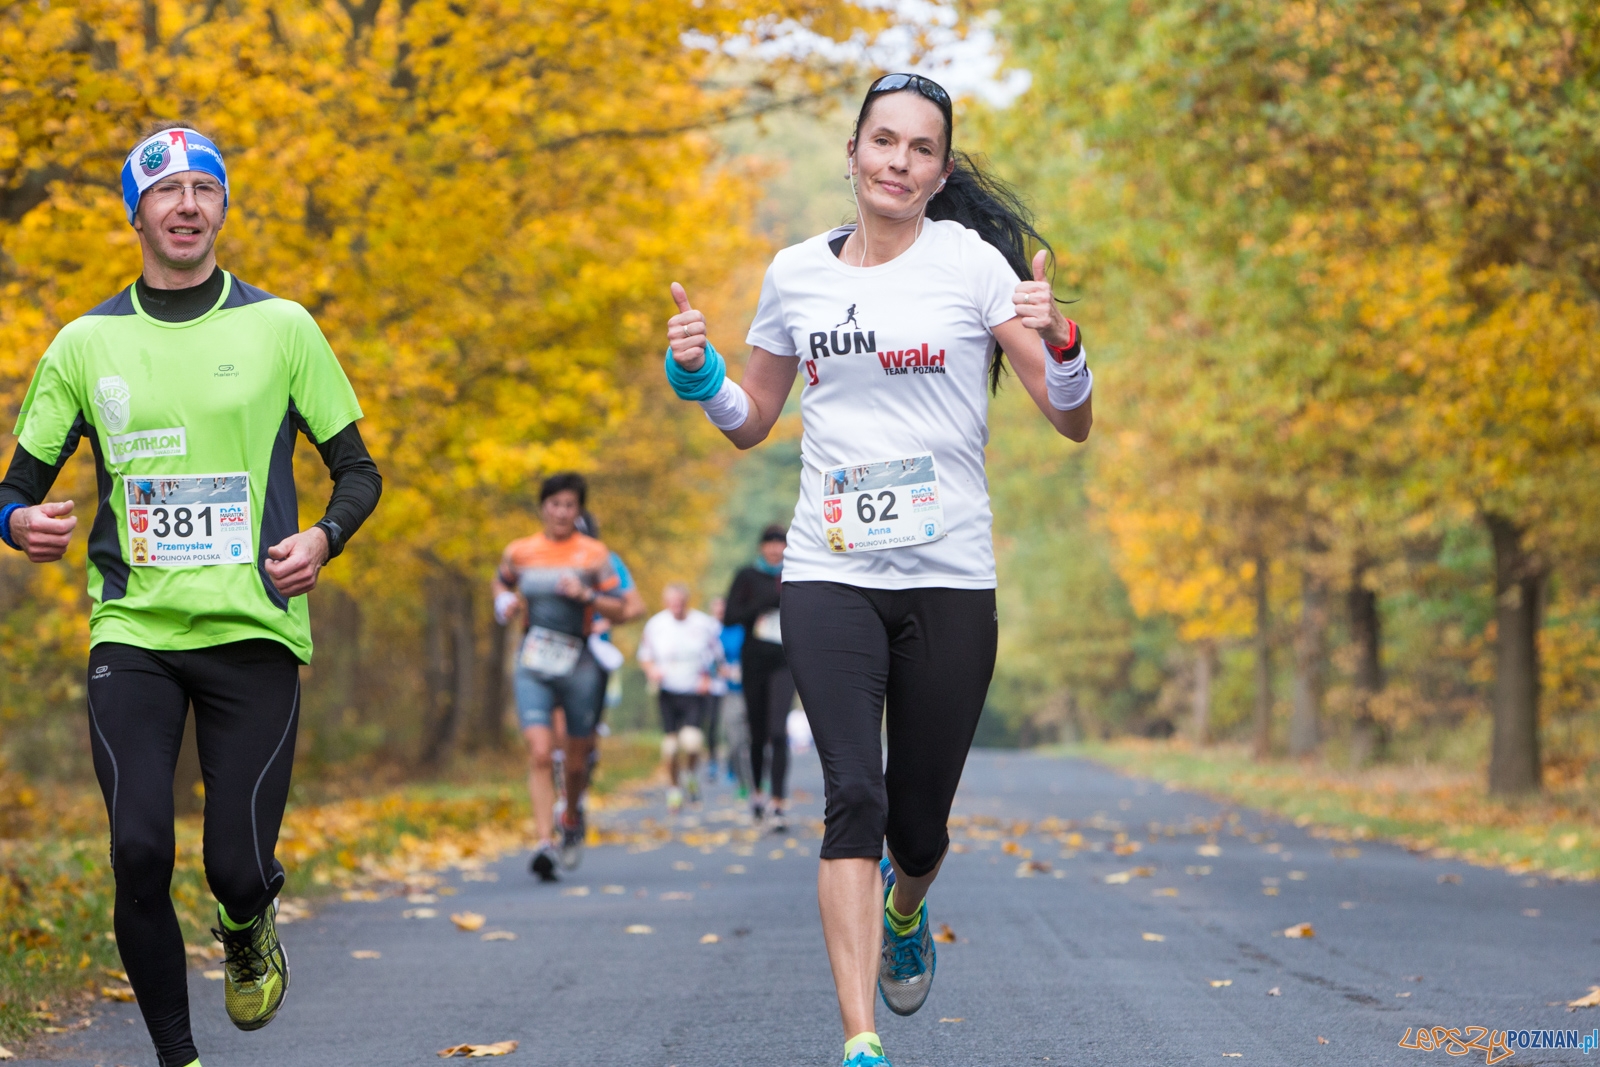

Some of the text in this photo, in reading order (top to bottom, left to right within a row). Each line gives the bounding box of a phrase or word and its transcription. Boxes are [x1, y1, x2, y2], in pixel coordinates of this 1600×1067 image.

[140, 144, 169, 165] WUEF
[809, 330, 877, 359] RUN
[877, 343, 946, 368] wald
[884, 367, 908, 376] TEAM
[96, 388, 129, 405] WUEF
[112, 434, 181, 457] DECATHLON
[856, 490, 899, 524] 62
[152, 506, 213, 538] 381
[867, 526, 892, 536] Anna
[156, 541, 213, 552] Przemysław
[854, 535, 916, 548] POLINOVA POLSKA
